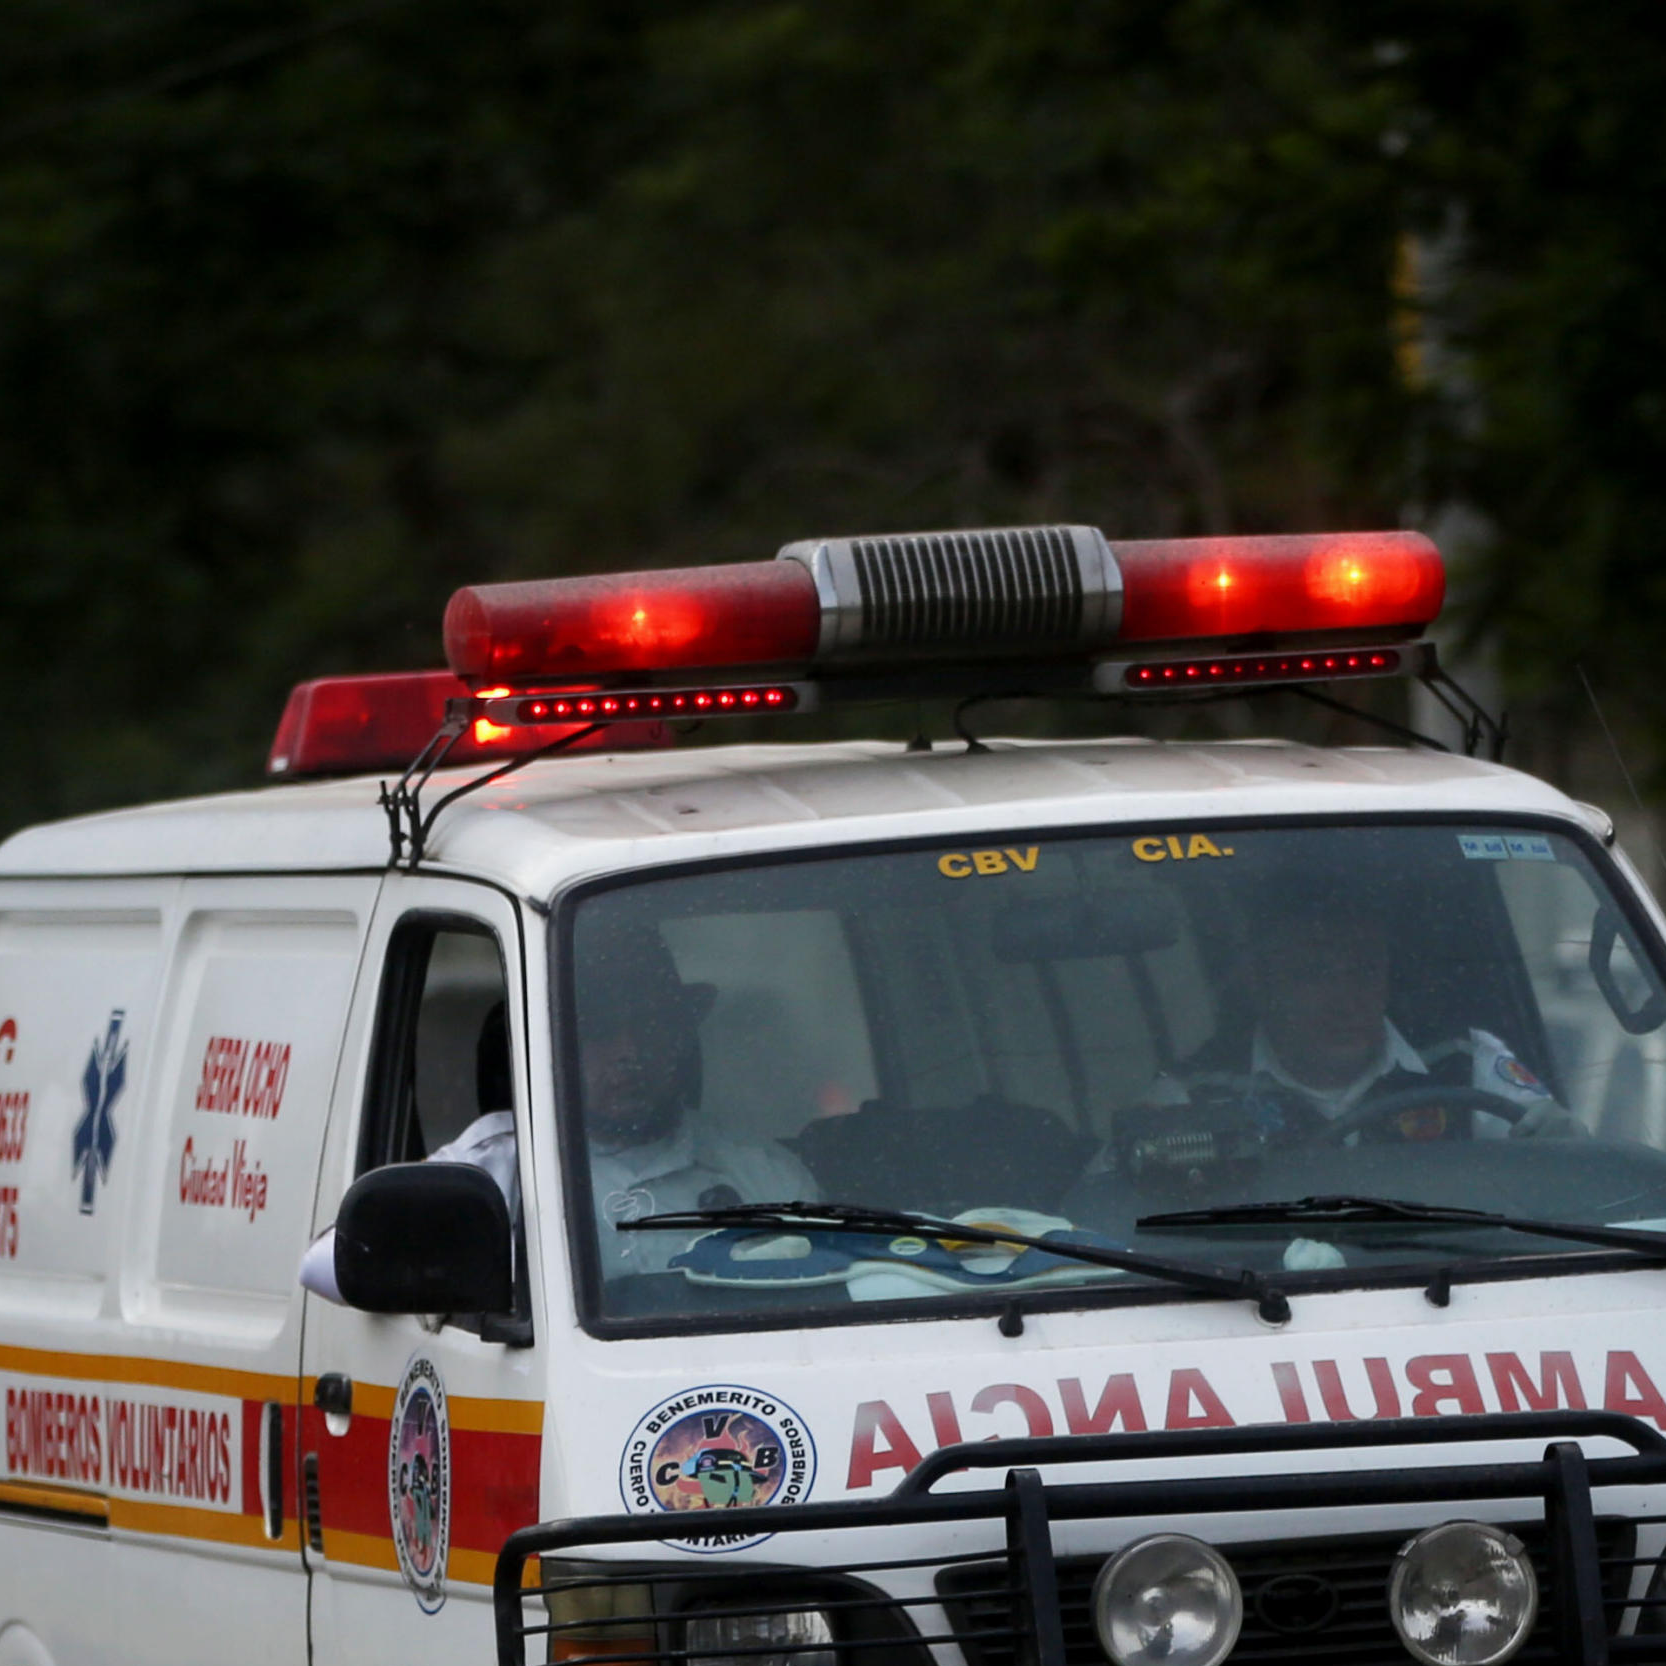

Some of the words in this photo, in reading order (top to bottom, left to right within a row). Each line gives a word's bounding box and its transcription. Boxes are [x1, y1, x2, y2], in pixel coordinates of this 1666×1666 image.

[937, 846, 1039, 878] CBV
[1132, 834, 1234, 862] CIA.
[196, 1037, 248, 1114] SIERRA
[243, 1041, 291, 1120] OCHO
[180, 1135, 229, 1206] Ciudad
[232, 1139, 268, 1223] Vieja
[6, 1389, 101, 1483] BOMBEROS
[106, 1399, 231, 1504] VOLUNTARIOS
[646, 1391, 776, 1434] BENEMERITO
[655, 1461, 680, 1487] C
[702, 1415, 729, 1439] V
[754, 1446, 780, 1470] B
[629, 1440, 650, 1508] CUERPO
[780, 1418, 806, 1505] BOMBEROS
